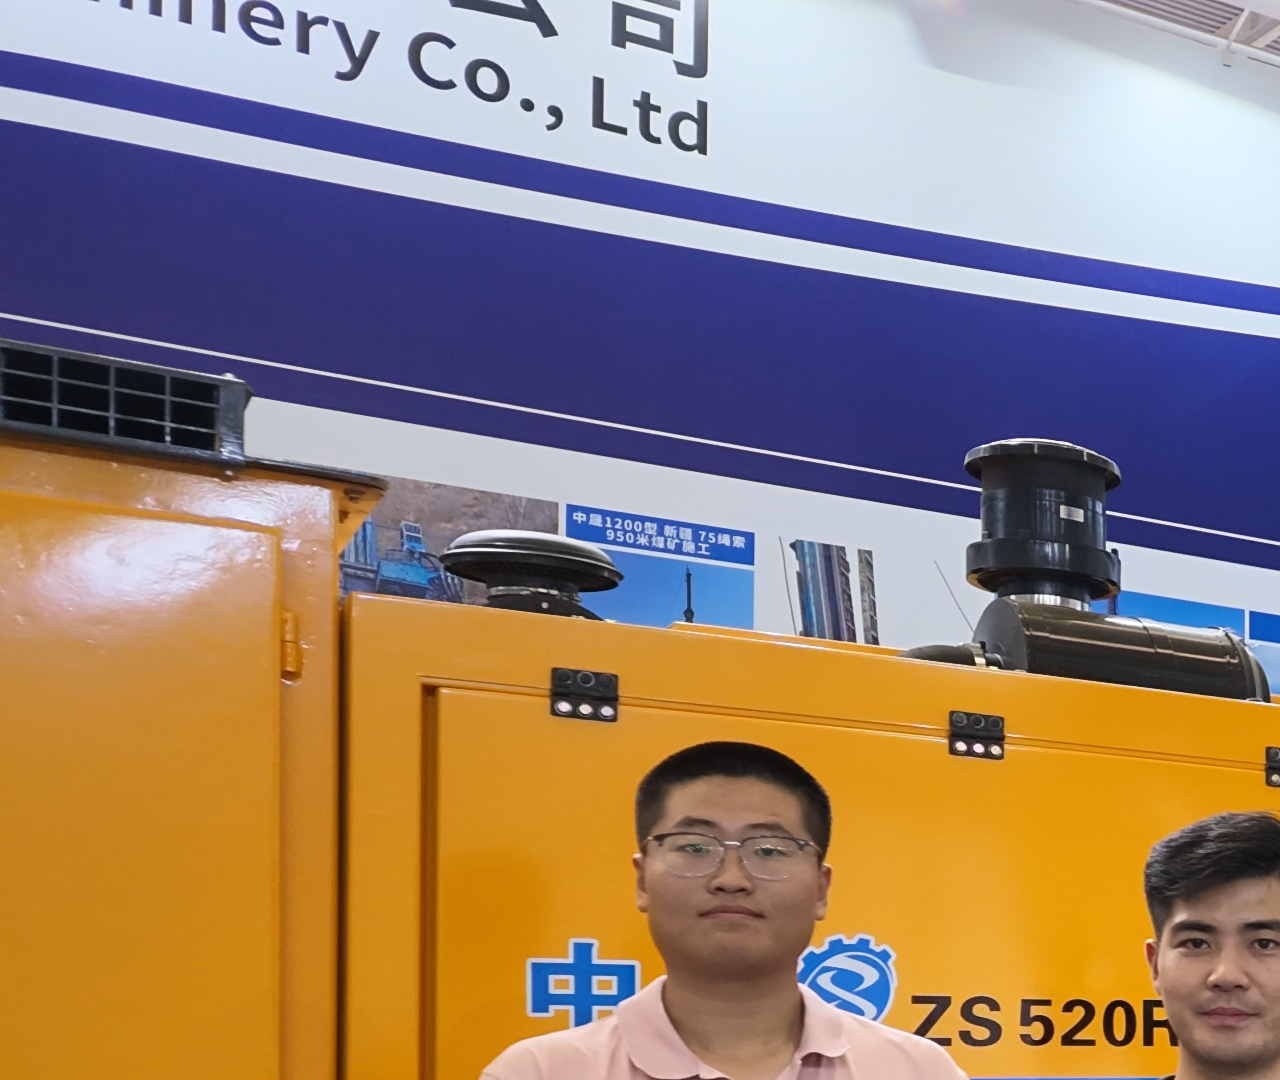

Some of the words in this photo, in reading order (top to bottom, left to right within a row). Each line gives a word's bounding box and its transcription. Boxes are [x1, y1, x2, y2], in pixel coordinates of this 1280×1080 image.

[406, 31, 564, 131] Co.,
[592, 76, 708, 156] Ltd
[905, 995, 1001, 1047] ZS
